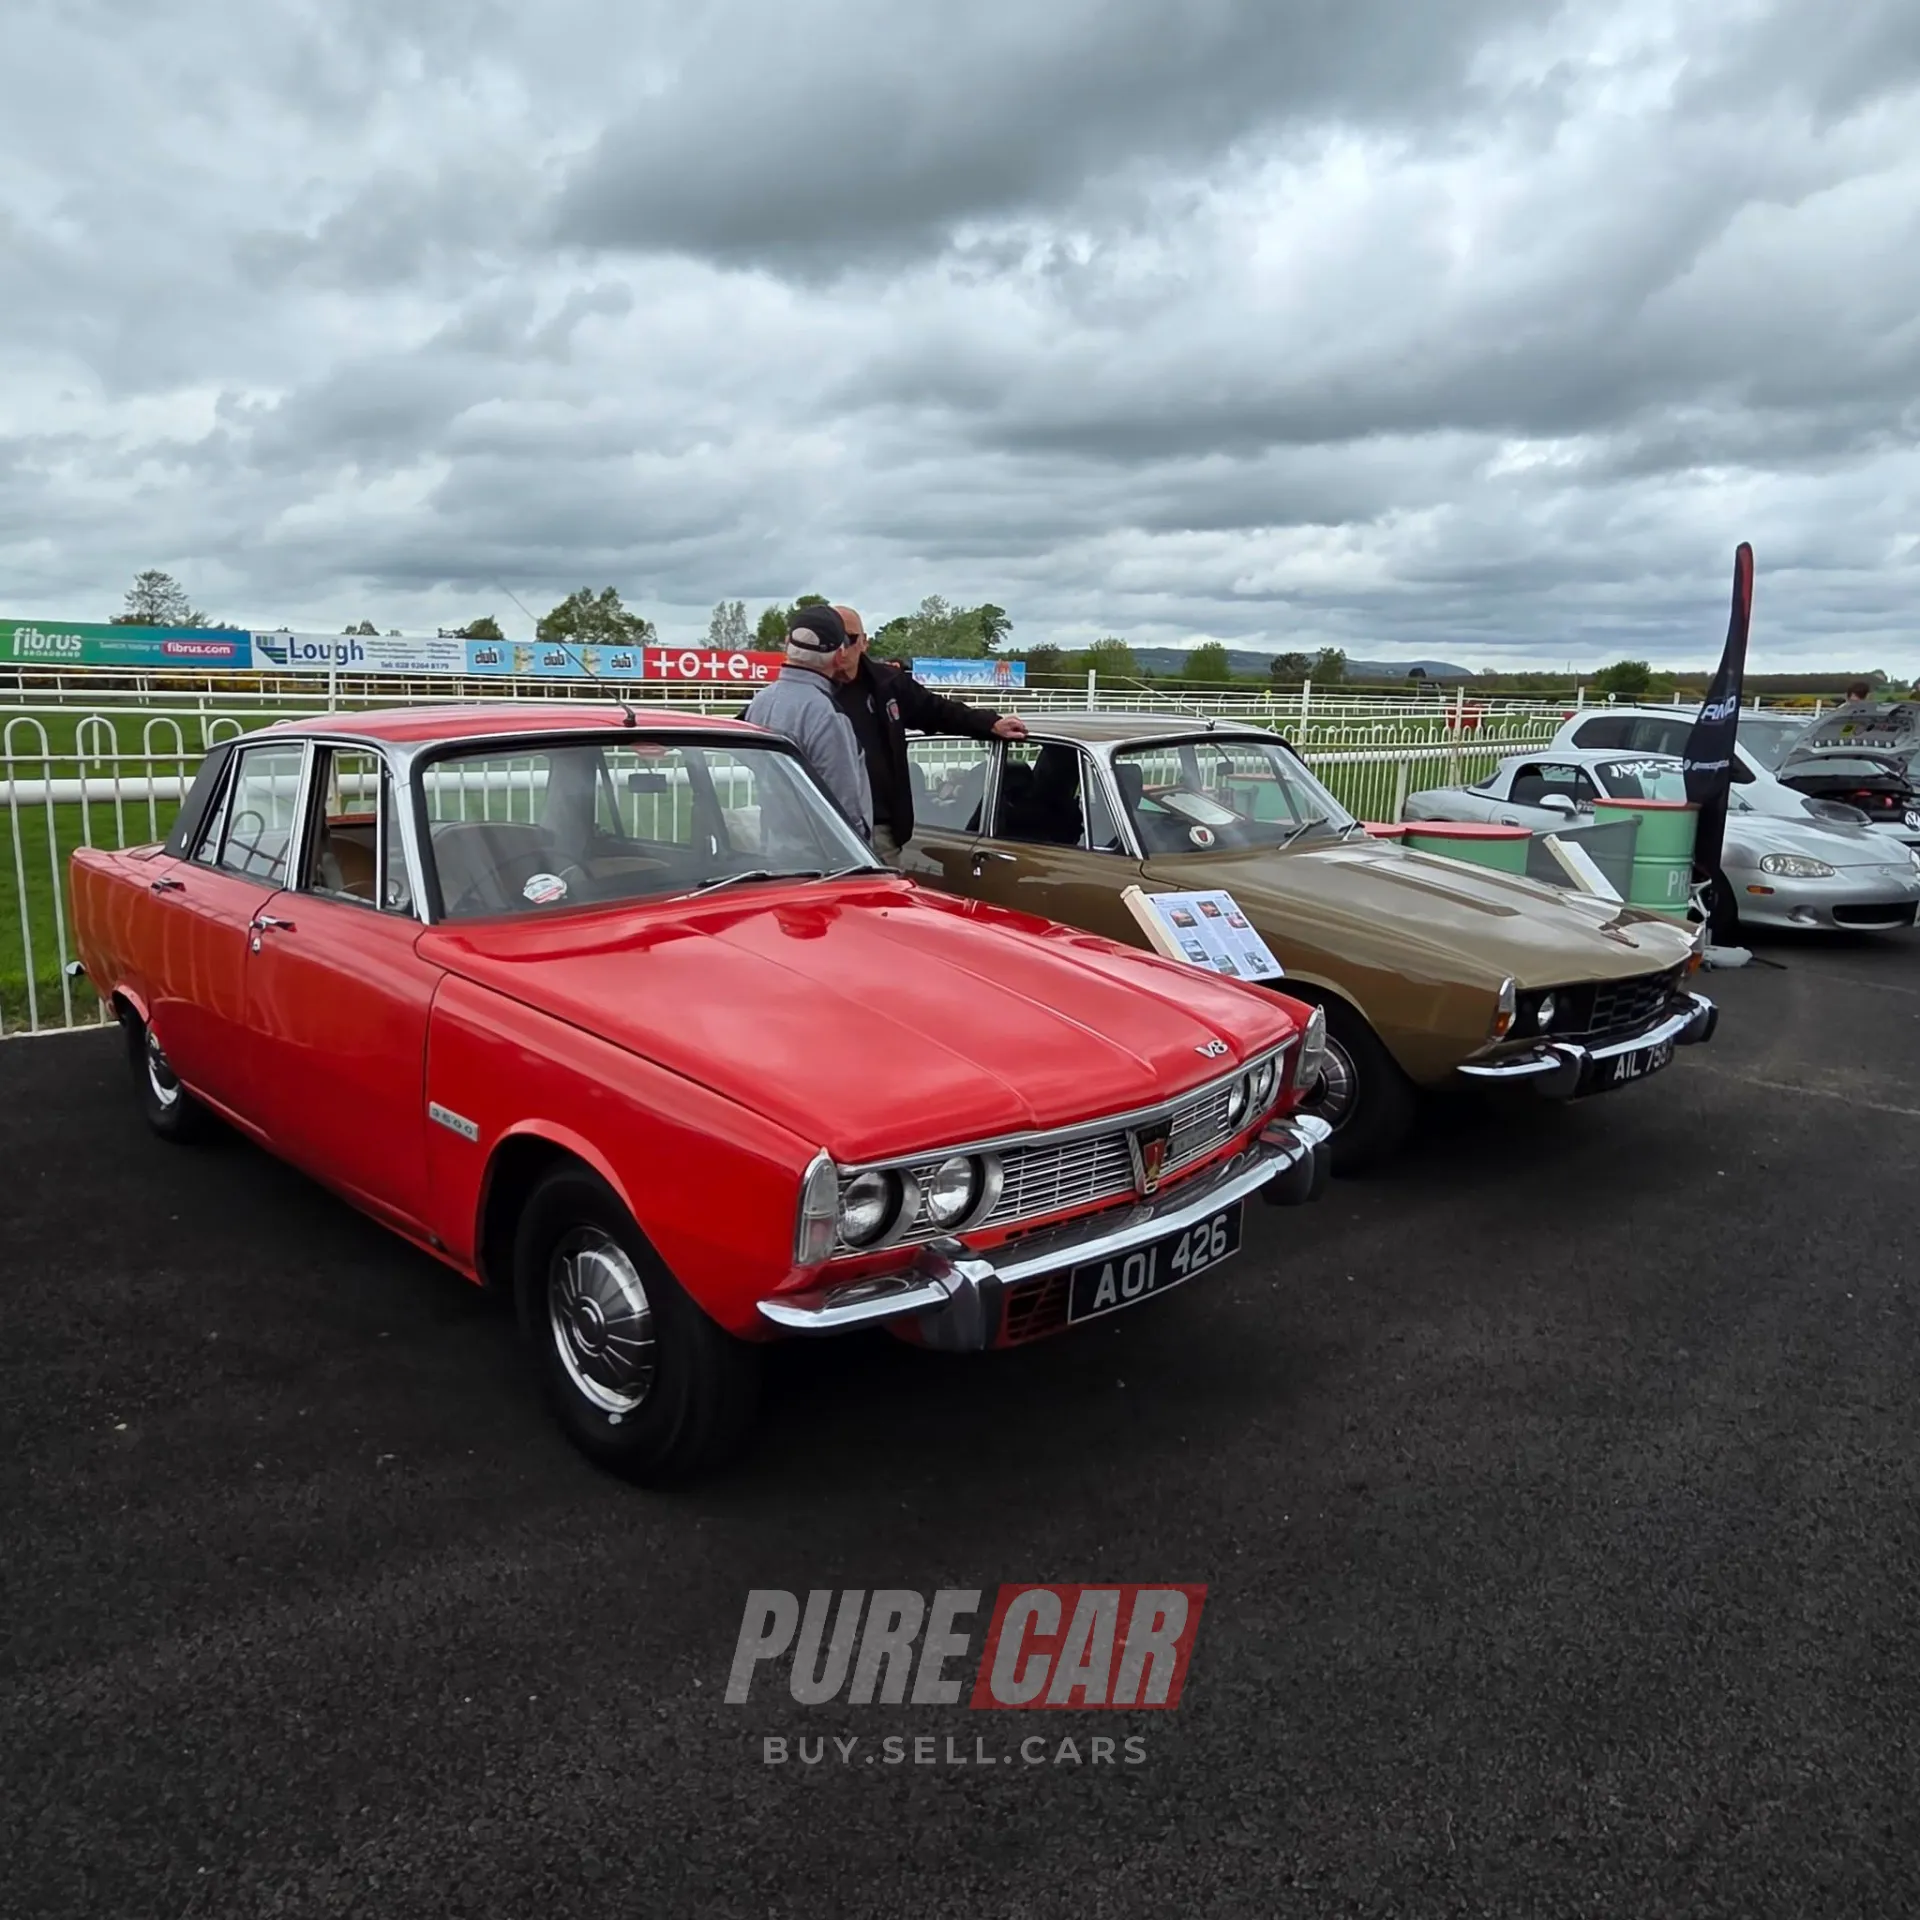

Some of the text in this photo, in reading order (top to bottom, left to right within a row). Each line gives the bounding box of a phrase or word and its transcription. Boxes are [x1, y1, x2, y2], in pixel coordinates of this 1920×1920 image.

[13, 628, 82, 656] fibrus
[23, 650, 81, 658] BROADBAND
[167, 642, 231, 654] fibrus.com
[290, 637, 364, 666] Lough
[1194, 1039, 1228, 1058] V8
[1614, 1052, 1641, 1080] AIL
[1093, 1214, 1228, 1309] AOI 426
